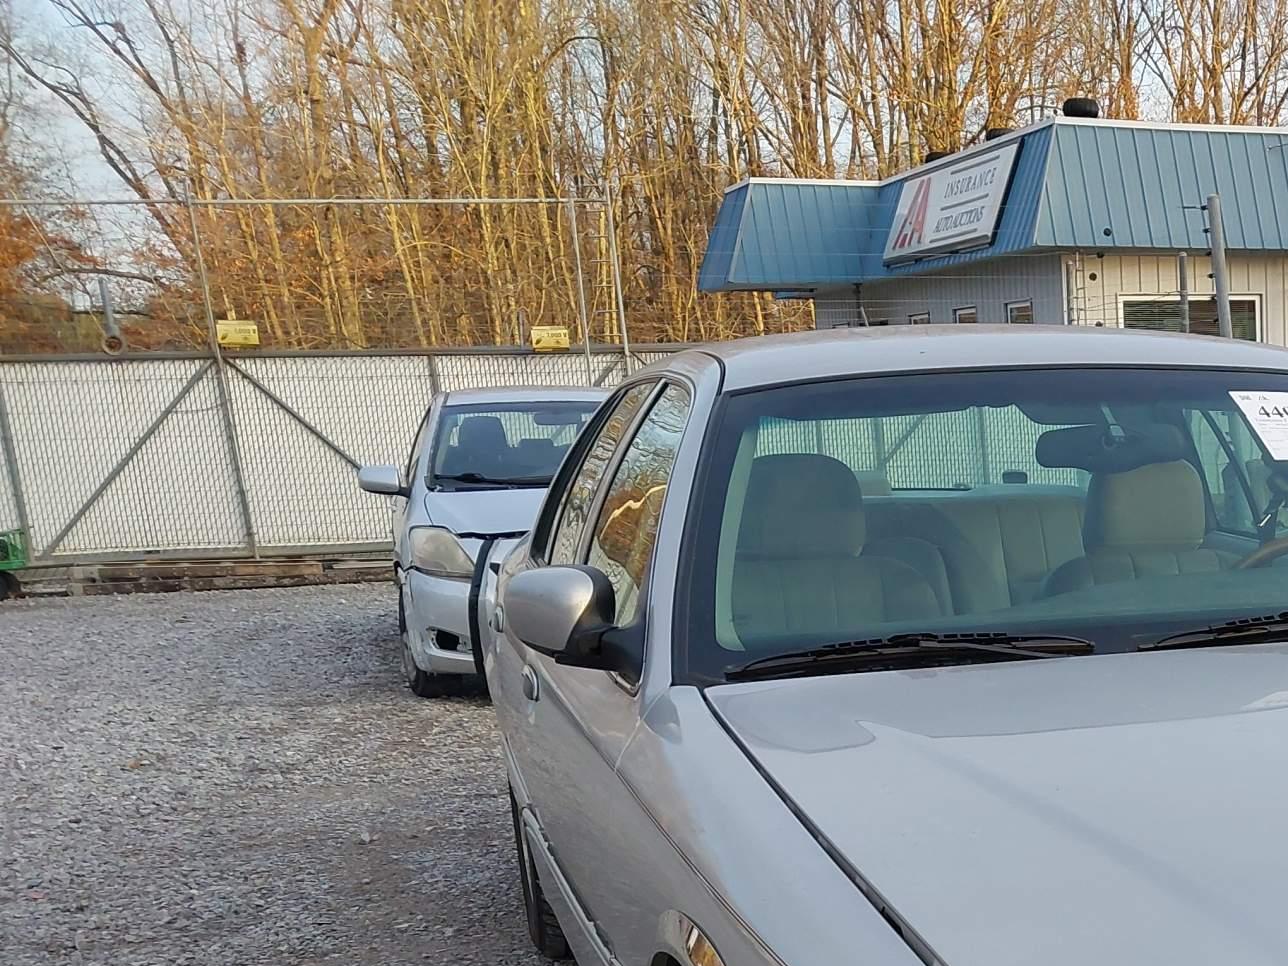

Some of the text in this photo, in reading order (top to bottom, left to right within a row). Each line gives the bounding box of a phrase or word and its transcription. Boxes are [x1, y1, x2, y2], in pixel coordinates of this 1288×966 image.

[944, 167, 998, 199] INSURANCE
[933, 206, 986, 234] AUTO AUCTIONS
